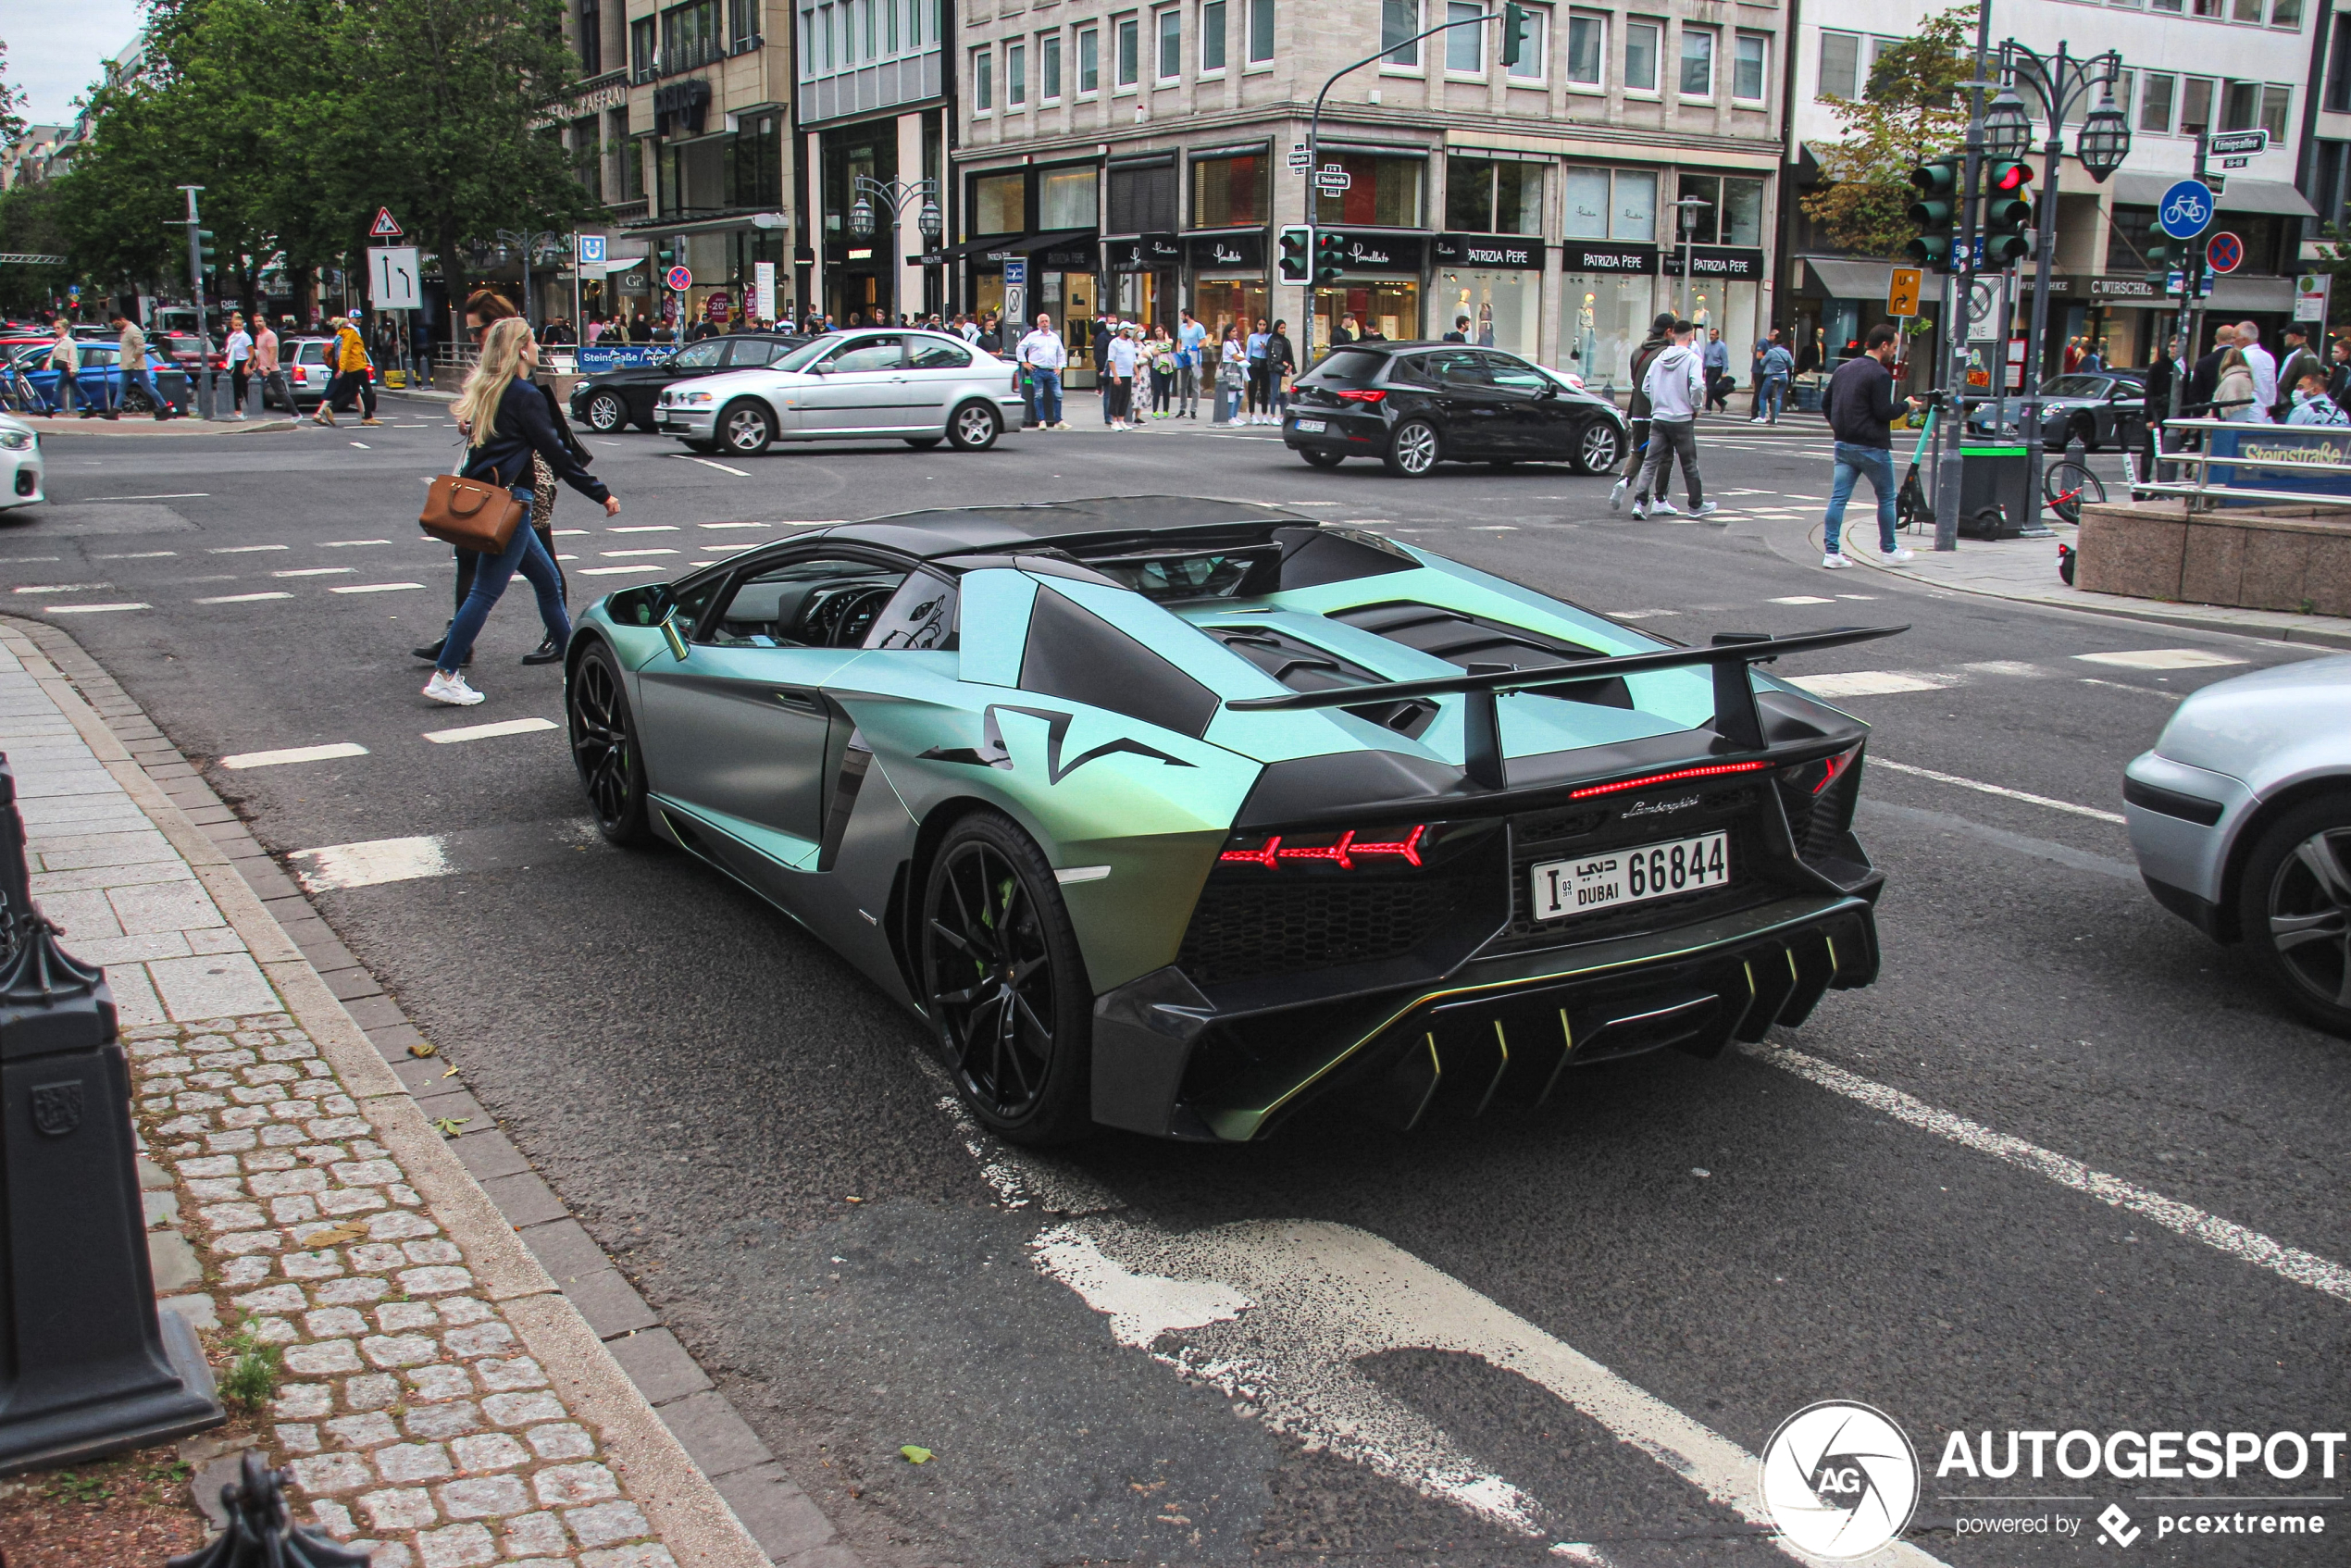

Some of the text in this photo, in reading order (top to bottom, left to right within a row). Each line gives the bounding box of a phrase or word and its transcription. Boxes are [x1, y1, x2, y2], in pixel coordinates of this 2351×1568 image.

[2214, 138, 2258, 151] Königsallee
[1321, 176, 1346, 185] Steinstraße
[1348, 242, 1389, 263] Pomellato
[1506, 250, 1527, 264] PEPE
[1584, 253, 1642, 268] PATRIZIA PEPE
[1693, 258, 1748, 273] PATRIZIA PEPE
[1898, 276, 1907, 286] U
[1967, 327, 1985, 337] ONE
[2245, 442, 2342, 468] Steinstraße
[1622, 794, 1699, 819] Lamborghini
[1576, 859, 1617, 882] دبي
[1629, 838, 1724, 896] 66844
[1547, 869, 1561, 912] I
[1562, 880, 1572, 891] 03
[1578, 882, 1619, 905] DUBAI
